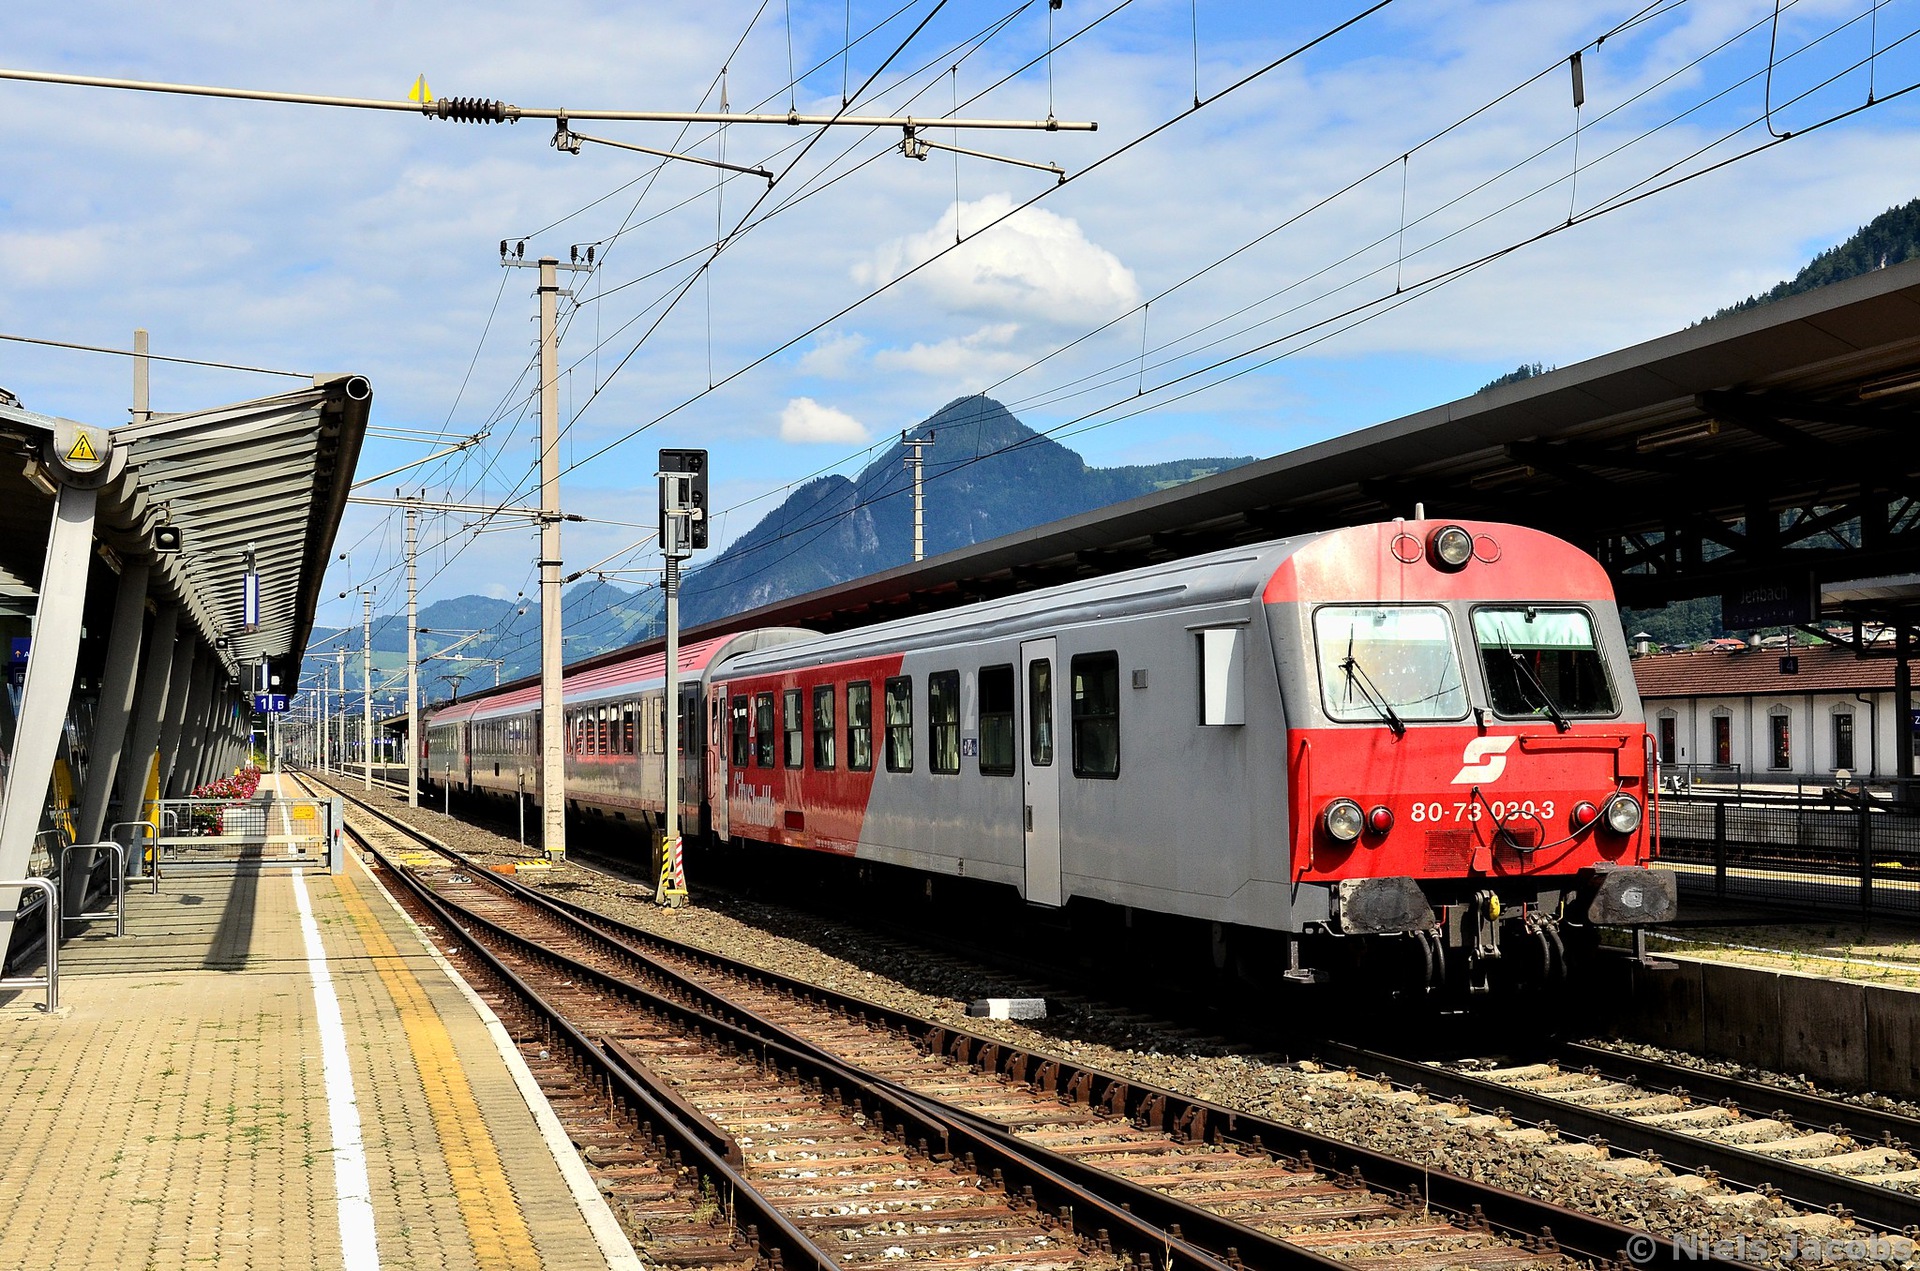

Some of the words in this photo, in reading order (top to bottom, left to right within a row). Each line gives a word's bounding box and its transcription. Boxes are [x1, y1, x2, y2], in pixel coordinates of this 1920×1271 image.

[1740, 581, 1788, 605] Jenbach
[261, 698, 267, 710] 1
[277, 700, 284, 710] B
[963, 671, 975, 730] 2
[749, 696, 757, 738] 2
[1410, 802, 1482, 822] 80-73
[1491, 800, 1555, 821] 030-3
